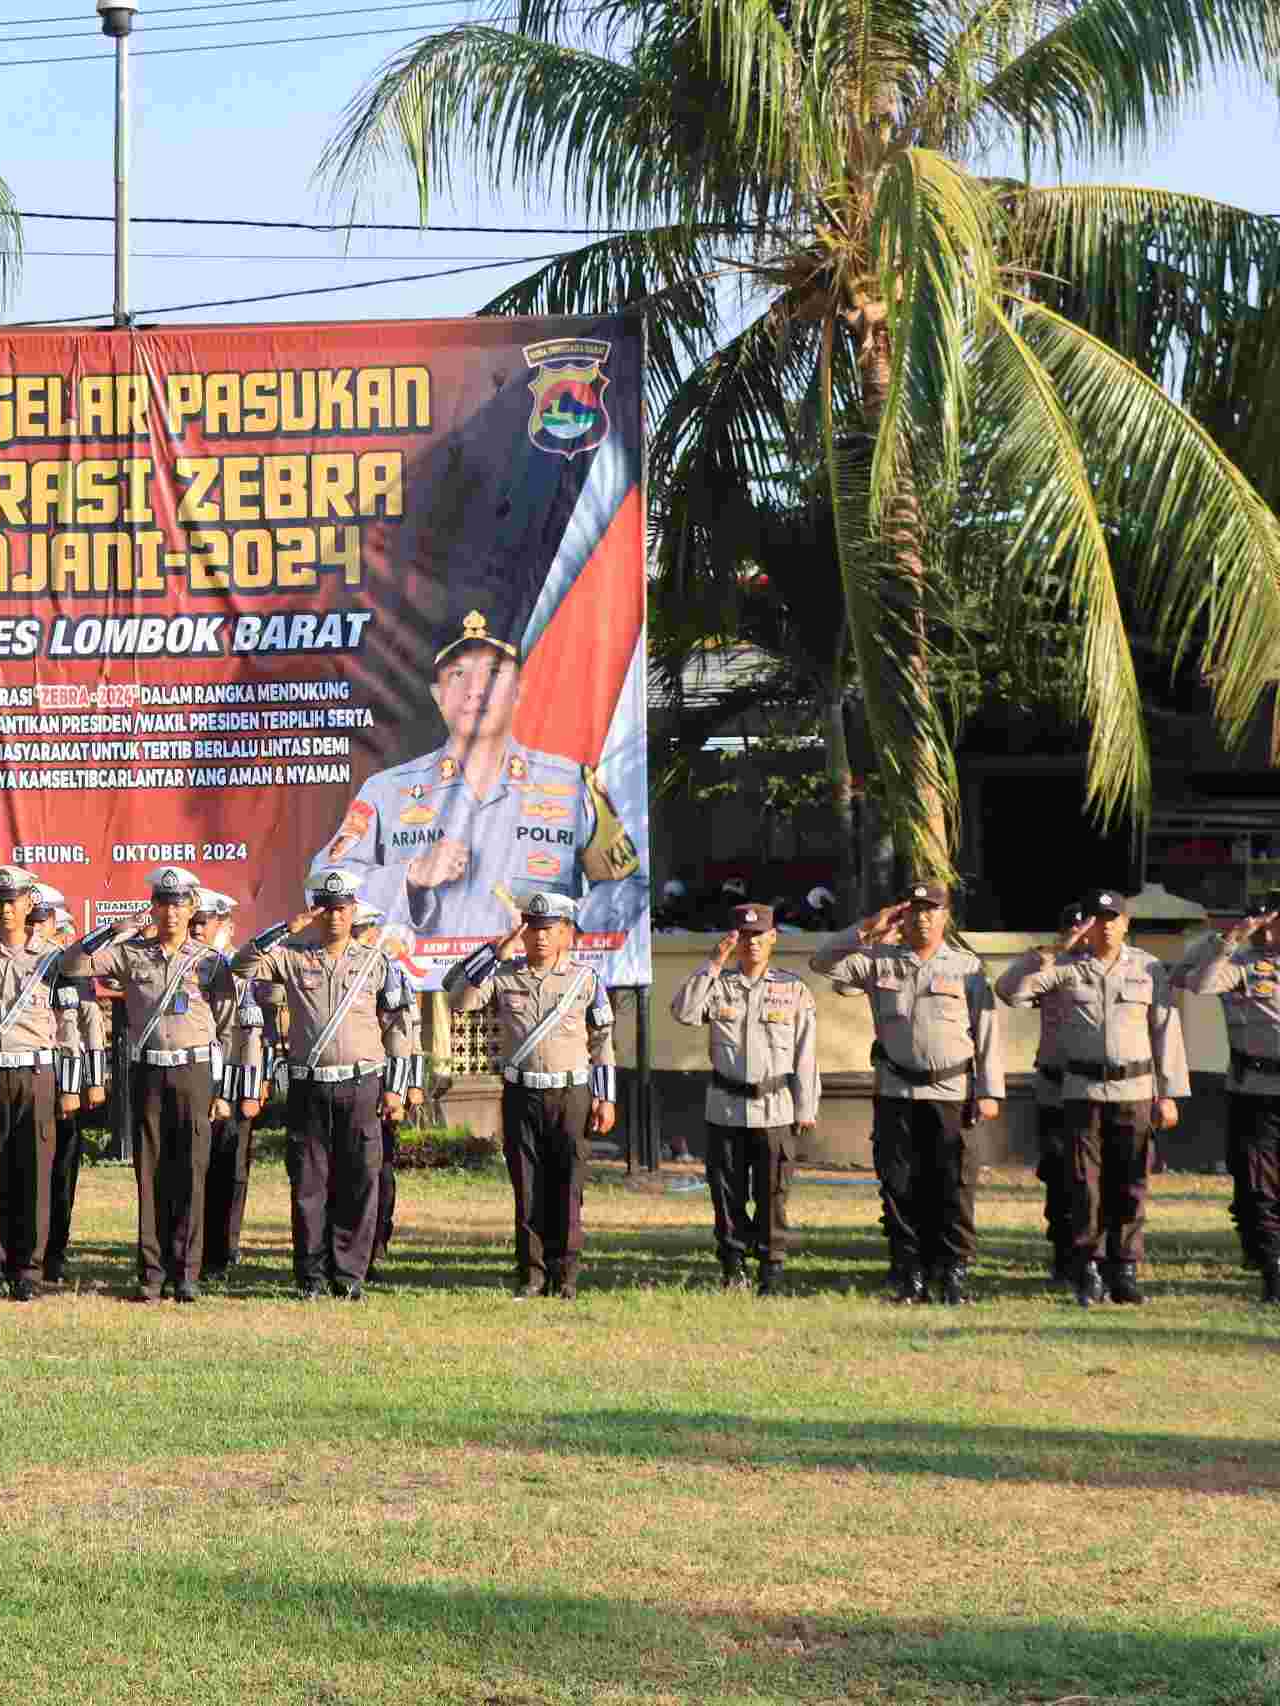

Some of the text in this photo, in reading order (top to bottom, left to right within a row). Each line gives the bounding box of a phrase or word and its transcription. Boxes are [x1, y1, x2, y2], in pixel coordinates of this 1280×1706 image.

[168, 367, 431, 433] PASUKAN
[176, 451, 403, 522] ZEBRA
[48, 616, 225, 655] LOMBOK
[232, 612, 372, 651] BARAT
[142, 685, 193, 705] DALAM
[194, 683, 257, 704] RANGKA
[258, 681, 350, 702] MENDUKUNG
[61, 713, 132, 734] PRESIDEN
[189, 711, 259, 732] PRESIDEN
[261, 710, 325, 730] TERPILIH
[327, 708, 375, 728] SERTA
[90, 741, 140, 761] UNTUK
[141, 740, 193, 761] TERTIB
[194, 739, 257, 759] BERLALU
[260, 737, 311, 757] LINTAS
[312, 736, 349, 756] DEMI
[19, 768, 186, 789] KAMSELTIBCARLANTAR
[187, 767, 227, 787] YANG
[229, 766, 272, 786] AMAN
[275, 765, 285, 785] &
[287, 763, 351, 784] NYAMAN
[516, 826, 575, 846] POLRI
[11, 842, 248, 865] GERUNG, OKTOBER 2024
